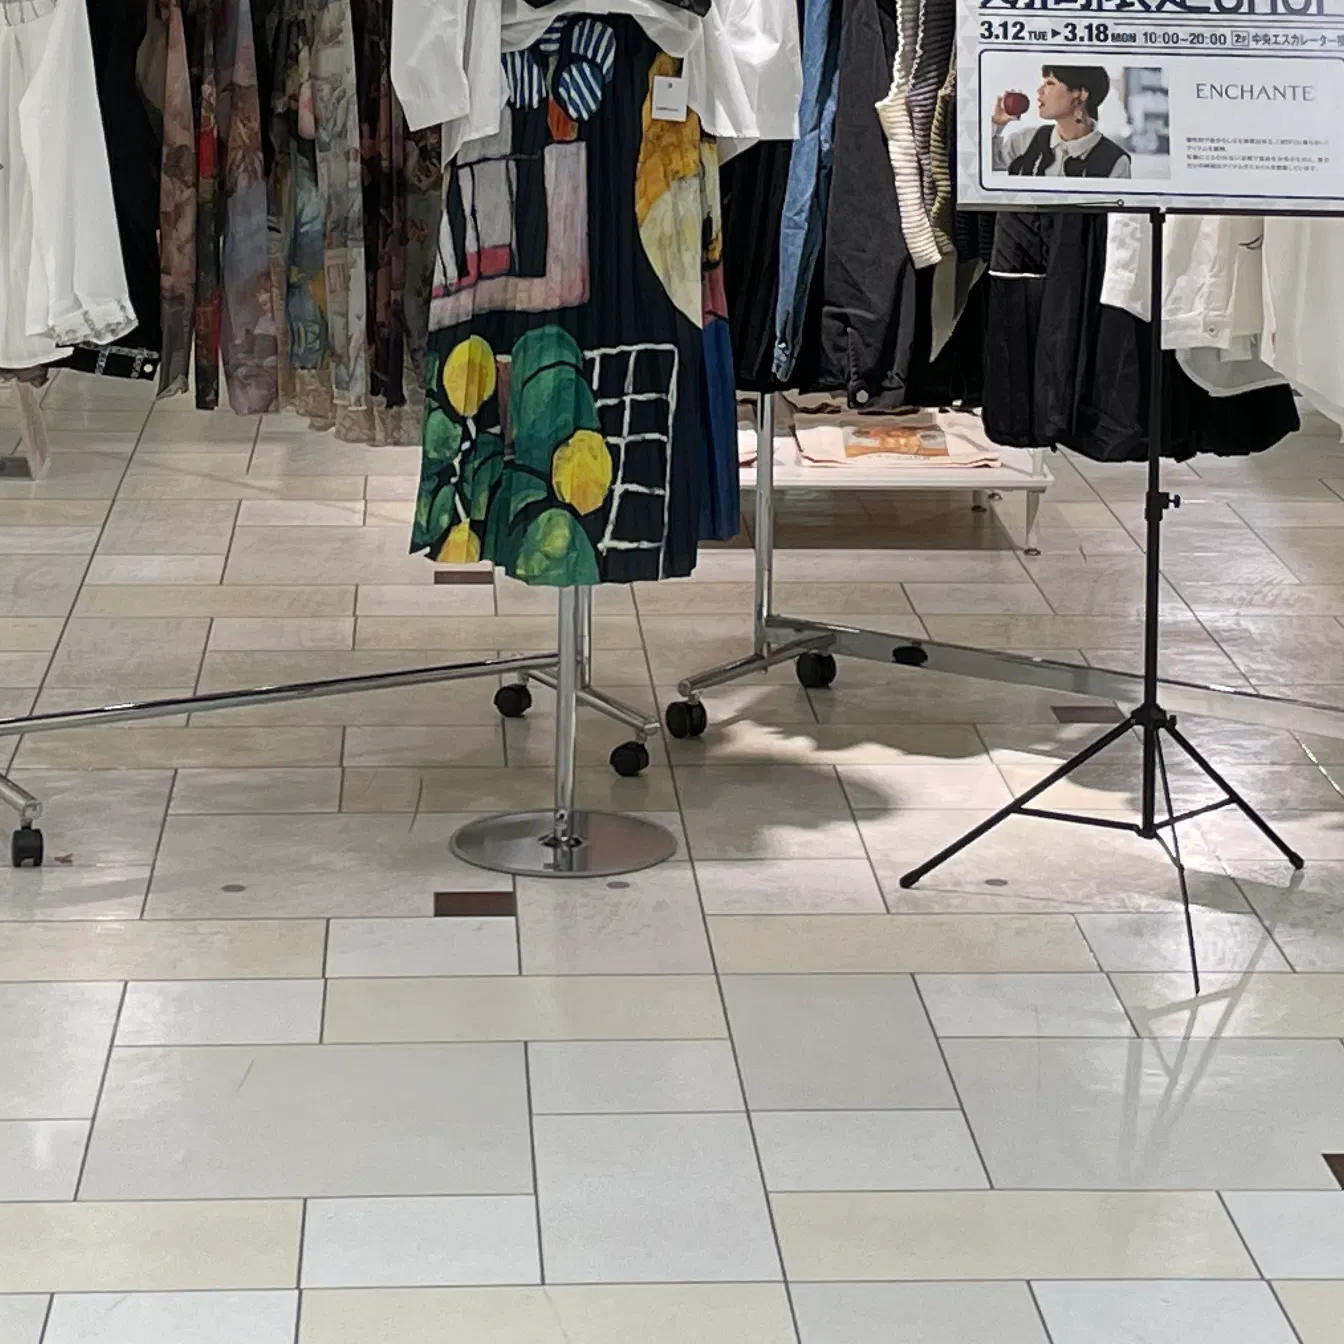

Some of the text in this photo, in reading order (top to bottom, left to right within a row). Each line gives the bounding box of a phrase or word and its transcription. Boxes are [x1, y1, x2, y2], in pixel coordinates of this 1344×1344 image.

[980, 21, 1026, 41] 3.12
[1028, 30, 1048, 41] TUE
[1064, 22, 1110, 44] 3.18
